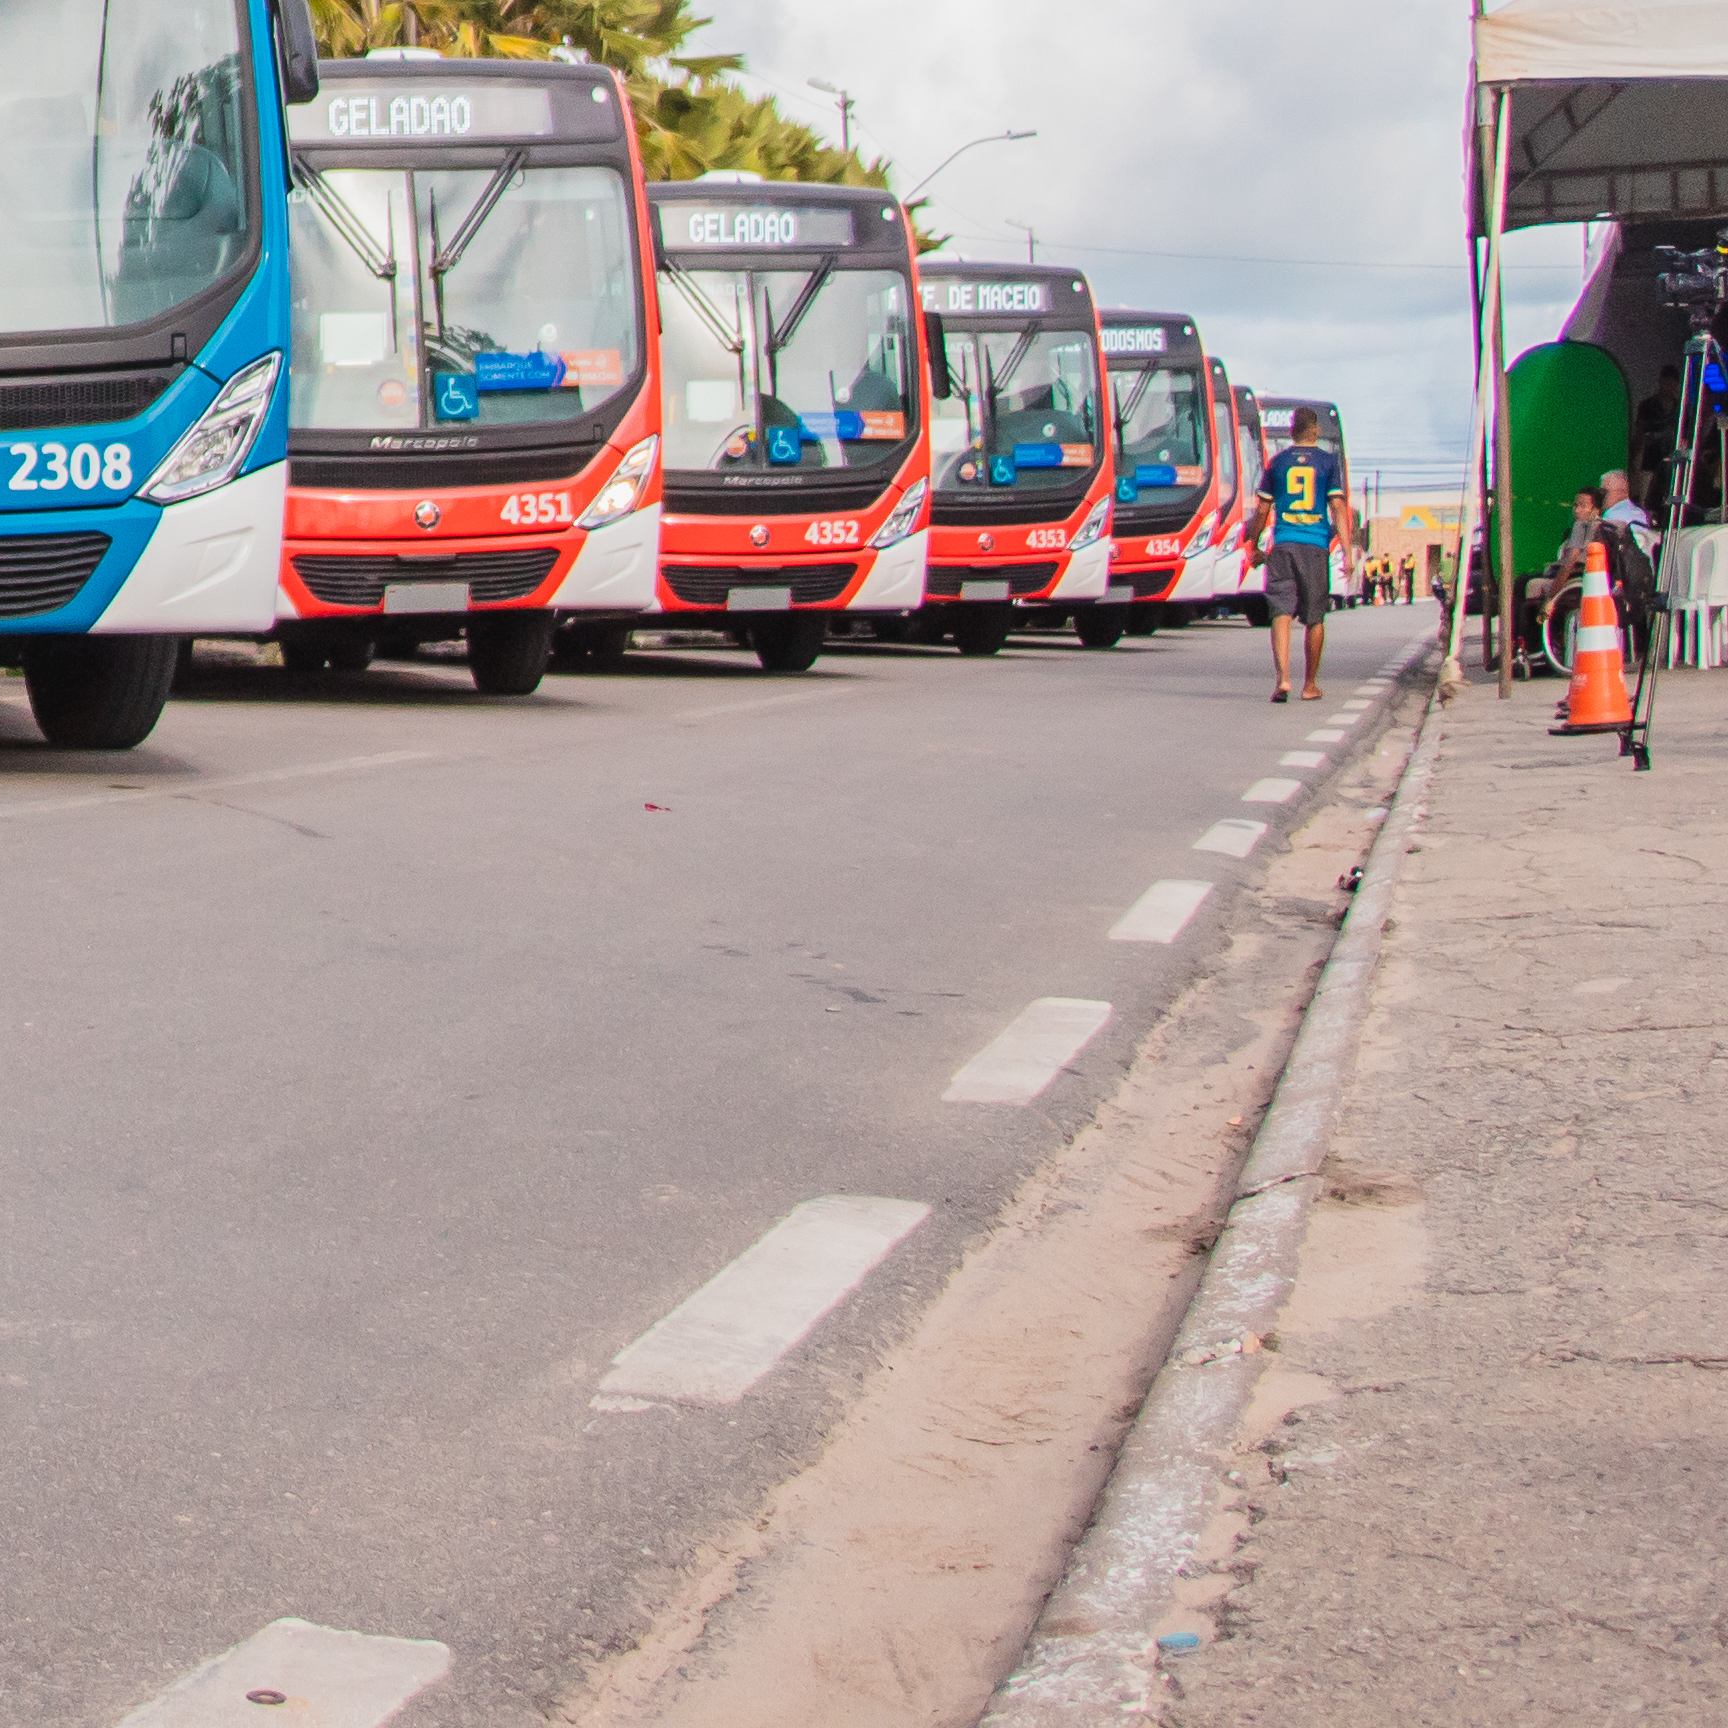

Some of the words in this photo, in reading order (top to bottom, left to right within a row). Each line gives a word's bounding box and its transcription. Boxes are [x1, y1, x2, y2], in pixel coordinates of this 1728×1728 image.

[328, 95, 472, 137] GELADAO
[688, 211, 796, 244] GELADAO
[948, 284, 973, 311] DE
[978, 284, 1042, 311] MACEIO
[370, 436, 479, 450] Marcopolo
[8, 442, 133, 491] 2308
[1287, 466, 1316, 511] 9
[500, 493, 573, 524] 4351
[804, 520, 860, 545] 4352
[1026, 529, 1067, 549] 4353
[1145, 539, 1181, 556] 4354
